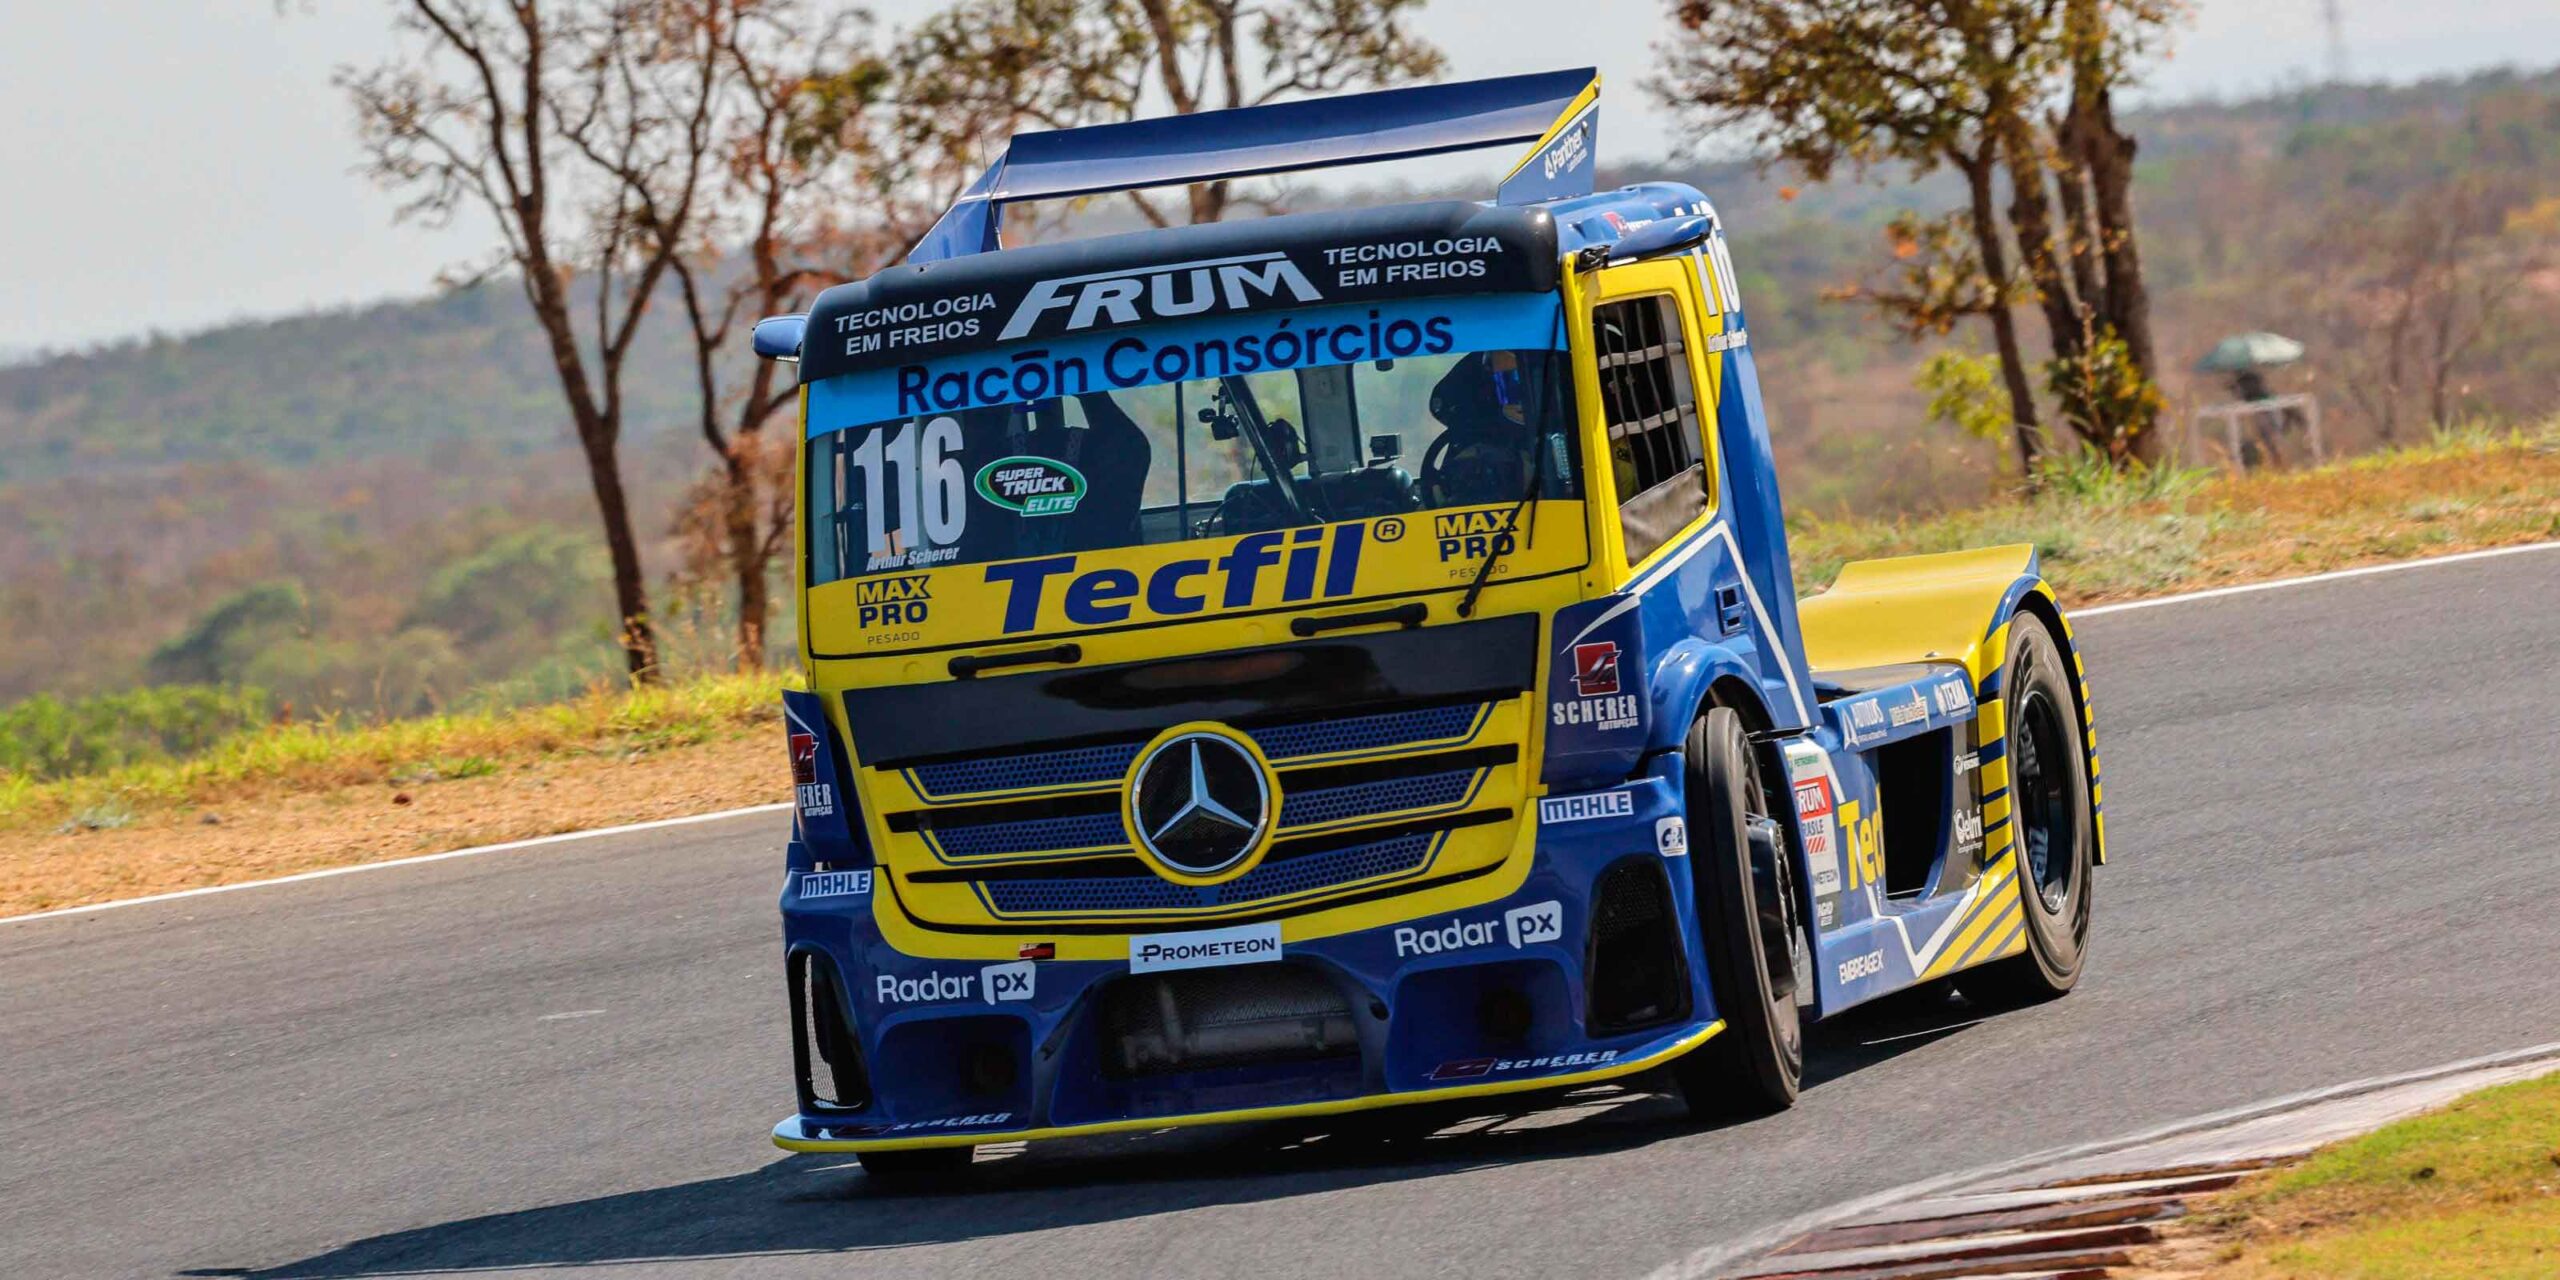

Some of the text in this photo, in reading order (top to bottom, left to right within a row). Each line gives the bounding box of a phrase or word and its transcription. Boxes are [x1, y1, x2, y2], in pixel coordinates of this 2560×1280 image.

[1324, 236, 1503, 265] TECNOLOGIA
[1339, 259, 1487, 288] EM FREIOS
[996, 251, 1324, 341] FRUM
[834, 293, 997, 333] TECNOLOGIA
[846, 318, 980, 356] EM FREIOS
[1104, 309, 1454, 388] Consórcios
[853, 416, 967, 553] 116
[995, 466, 1045, 483] SUPER
[1003, 476, 1067, 496] TRUCK
[1025, 496, 1076, 514] ELITE
[1437, 509, 1515, 538] MAX
[866, 546, 960, 571] Arthur Scherer
[1440, 533, 1516, 562] PRO
[984, 522, 1365, 635] Tecfil
[1450, 565, 1508, 579] PESDO
[858, 574, 931, 605] MAX
[860, 602, 928, 628] PRO
[867, 631, 920, 645] PESADO
[1552, 695, 1638, 726] SCHERER
[1544, 793, 1631, 821] MAHLE
[803, 873, 869, 897] MAHLE
[1137, 937, 1275, 962] PROMETEON
[1394, 913, 1555, 957] Radar px
[1839, 948, 1884, 985] EMBREAGEX
[876, 970, 1029, 1003] Radar px
[1495, 1050, 1619, 1070] SCHERER
